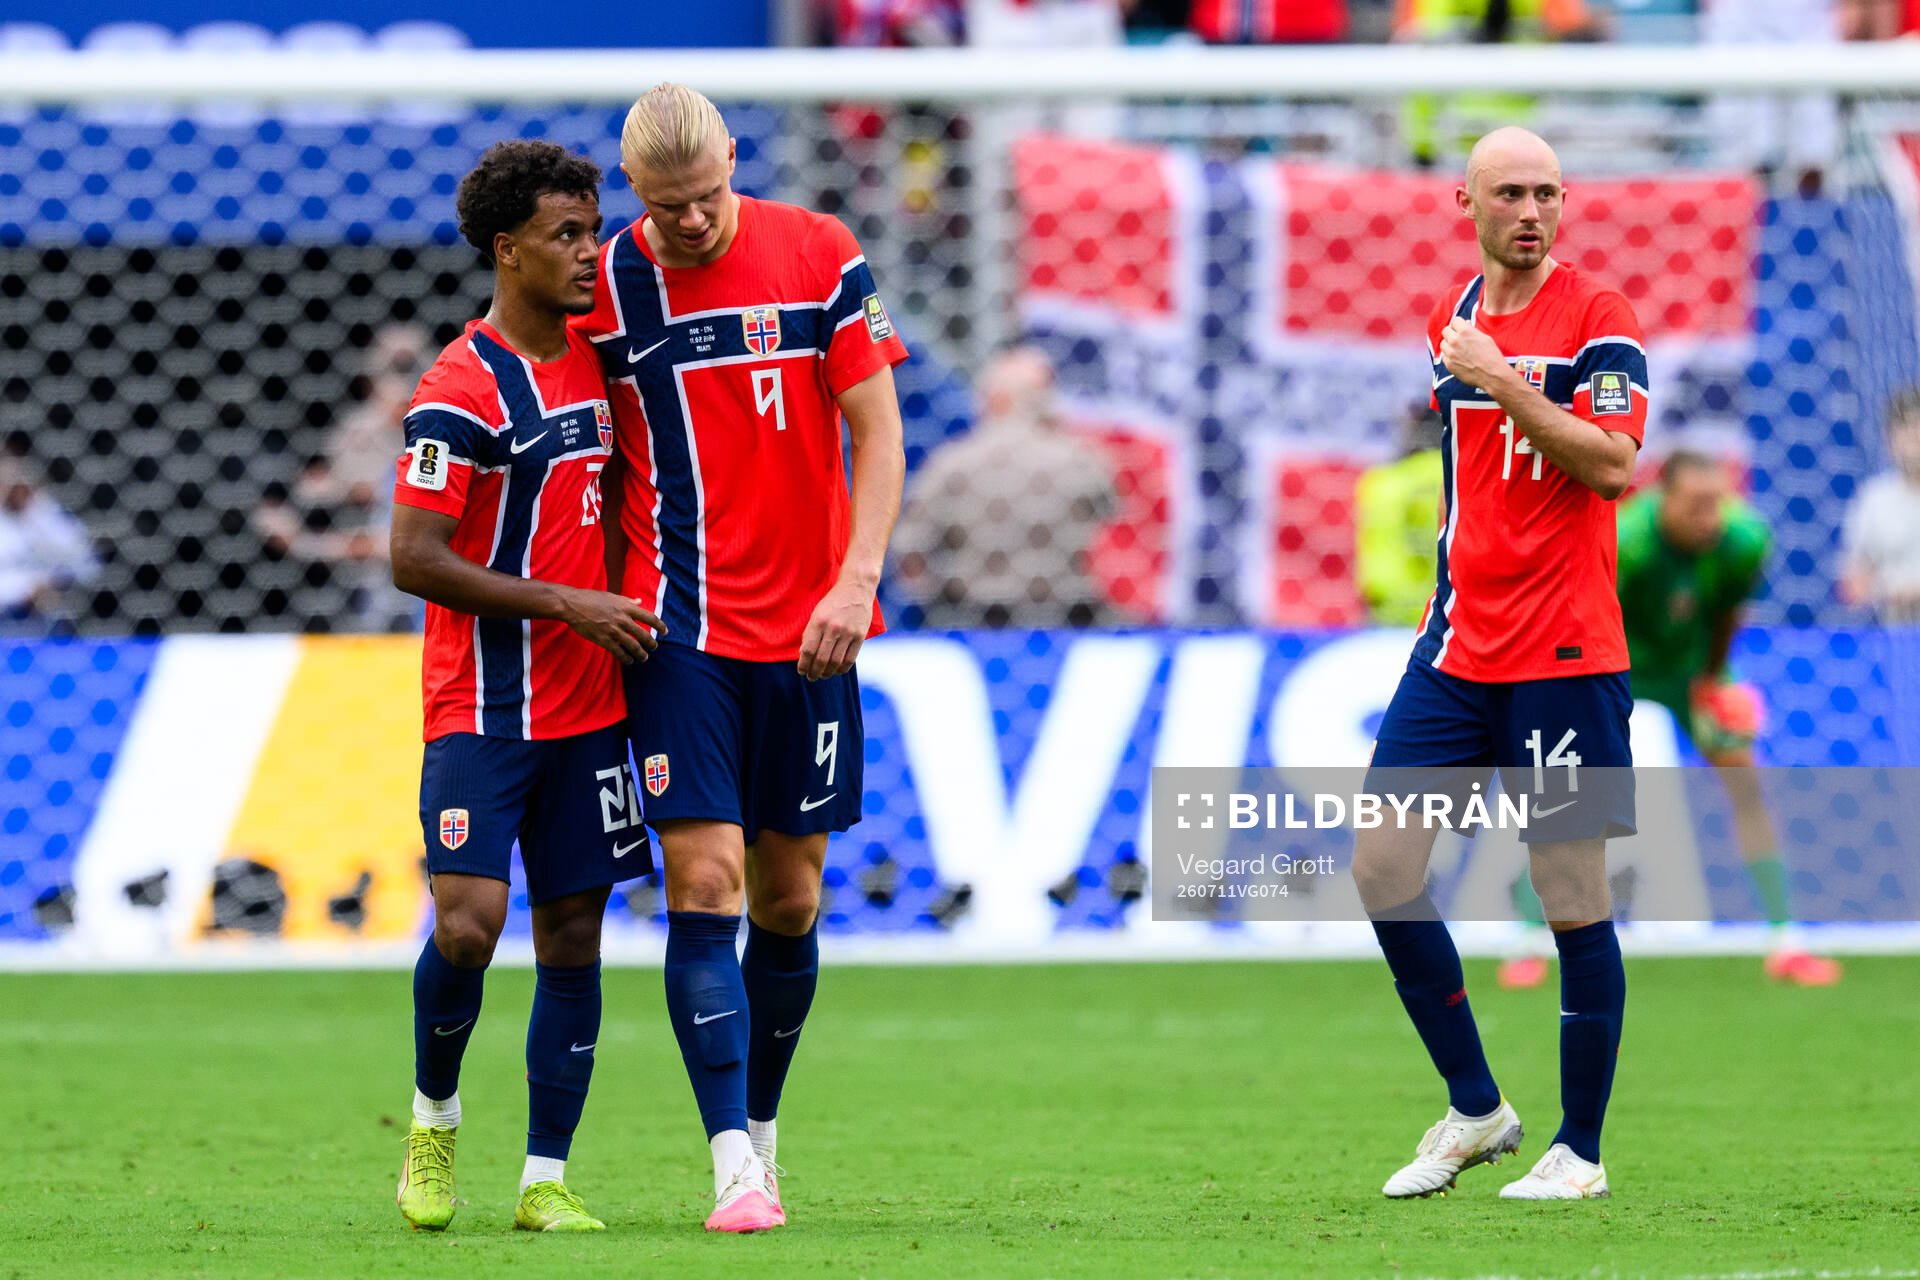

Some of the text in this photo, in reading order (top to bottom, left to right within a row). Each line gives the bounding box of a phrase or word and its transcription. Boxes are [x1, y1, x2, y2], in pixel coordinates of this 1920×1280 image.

[750, 367, 787, 431] 9
[1499, 415, 1543, 480] 14
[416, 478, 435, 486] 2026
[815, 720, 839, 786] 9
[1525, 728, 1582, 794] 14
